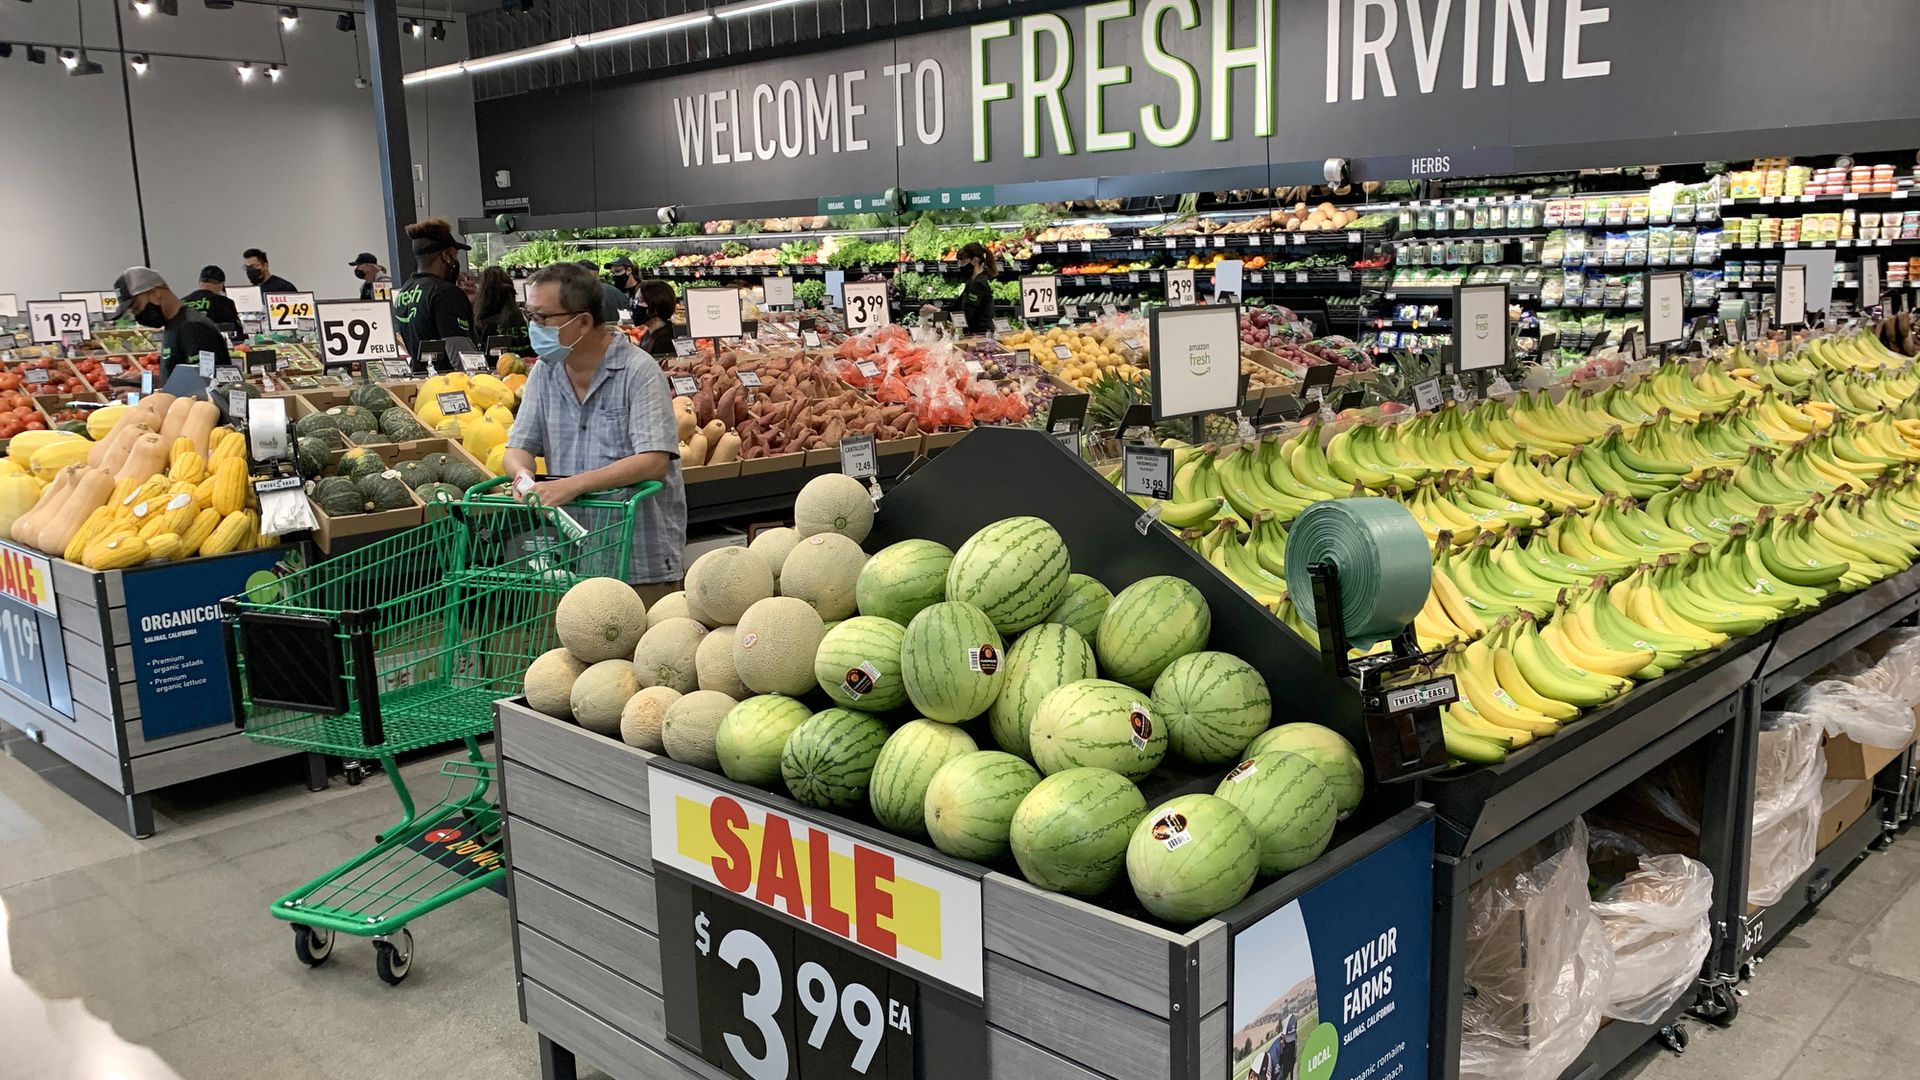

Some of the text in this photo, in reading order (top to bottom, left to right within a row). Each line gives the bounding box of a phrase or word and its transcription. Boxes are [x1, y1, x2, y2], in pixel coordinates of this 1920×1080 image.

[673, 0, 1612, 167] WELCOME TO FRESH IRVINE
[1411, 156, 1450, 174] HERBS
[912, 196, 930, 204] ORGANIC
[961, 192, 980, 201] ORGANIC
[394, 284, 422, 308] fresh
[386, 344, 395, 352] LB
[1189, 343, 1210, 352] amazon
[1189, 352, 1210, 365] fresh
[845, 444, 870, 453] CANTALOUPE
[856, 461, 871, 471] $2.49
[1142, 477, 1163, 490] $3.99
[144, 629, 197, 644] SALINAS, CALIFORNIA
[152, 654, 184, 666] Premium
[154, 659, 204, 674] organic salads
[155, 674, 187, 685] Premium
[156, 678, 207, 693] organic lettuce
[1394, 687, 1447, 706] TWIST EASE
[709, 796, 898, 959] SALE
[1344, 926, 1398, 986] TAYLOR
[1344, 965, 1392, 1025] FARMS
[888, 998, 912, 1036] EA
[1344, 1001, 1396, 1046] SALINAS, CALIFORNIA
[1308, 1046, 1331, 1073] LOCAL
[1377, 1042, 1406, 1069] romaine
